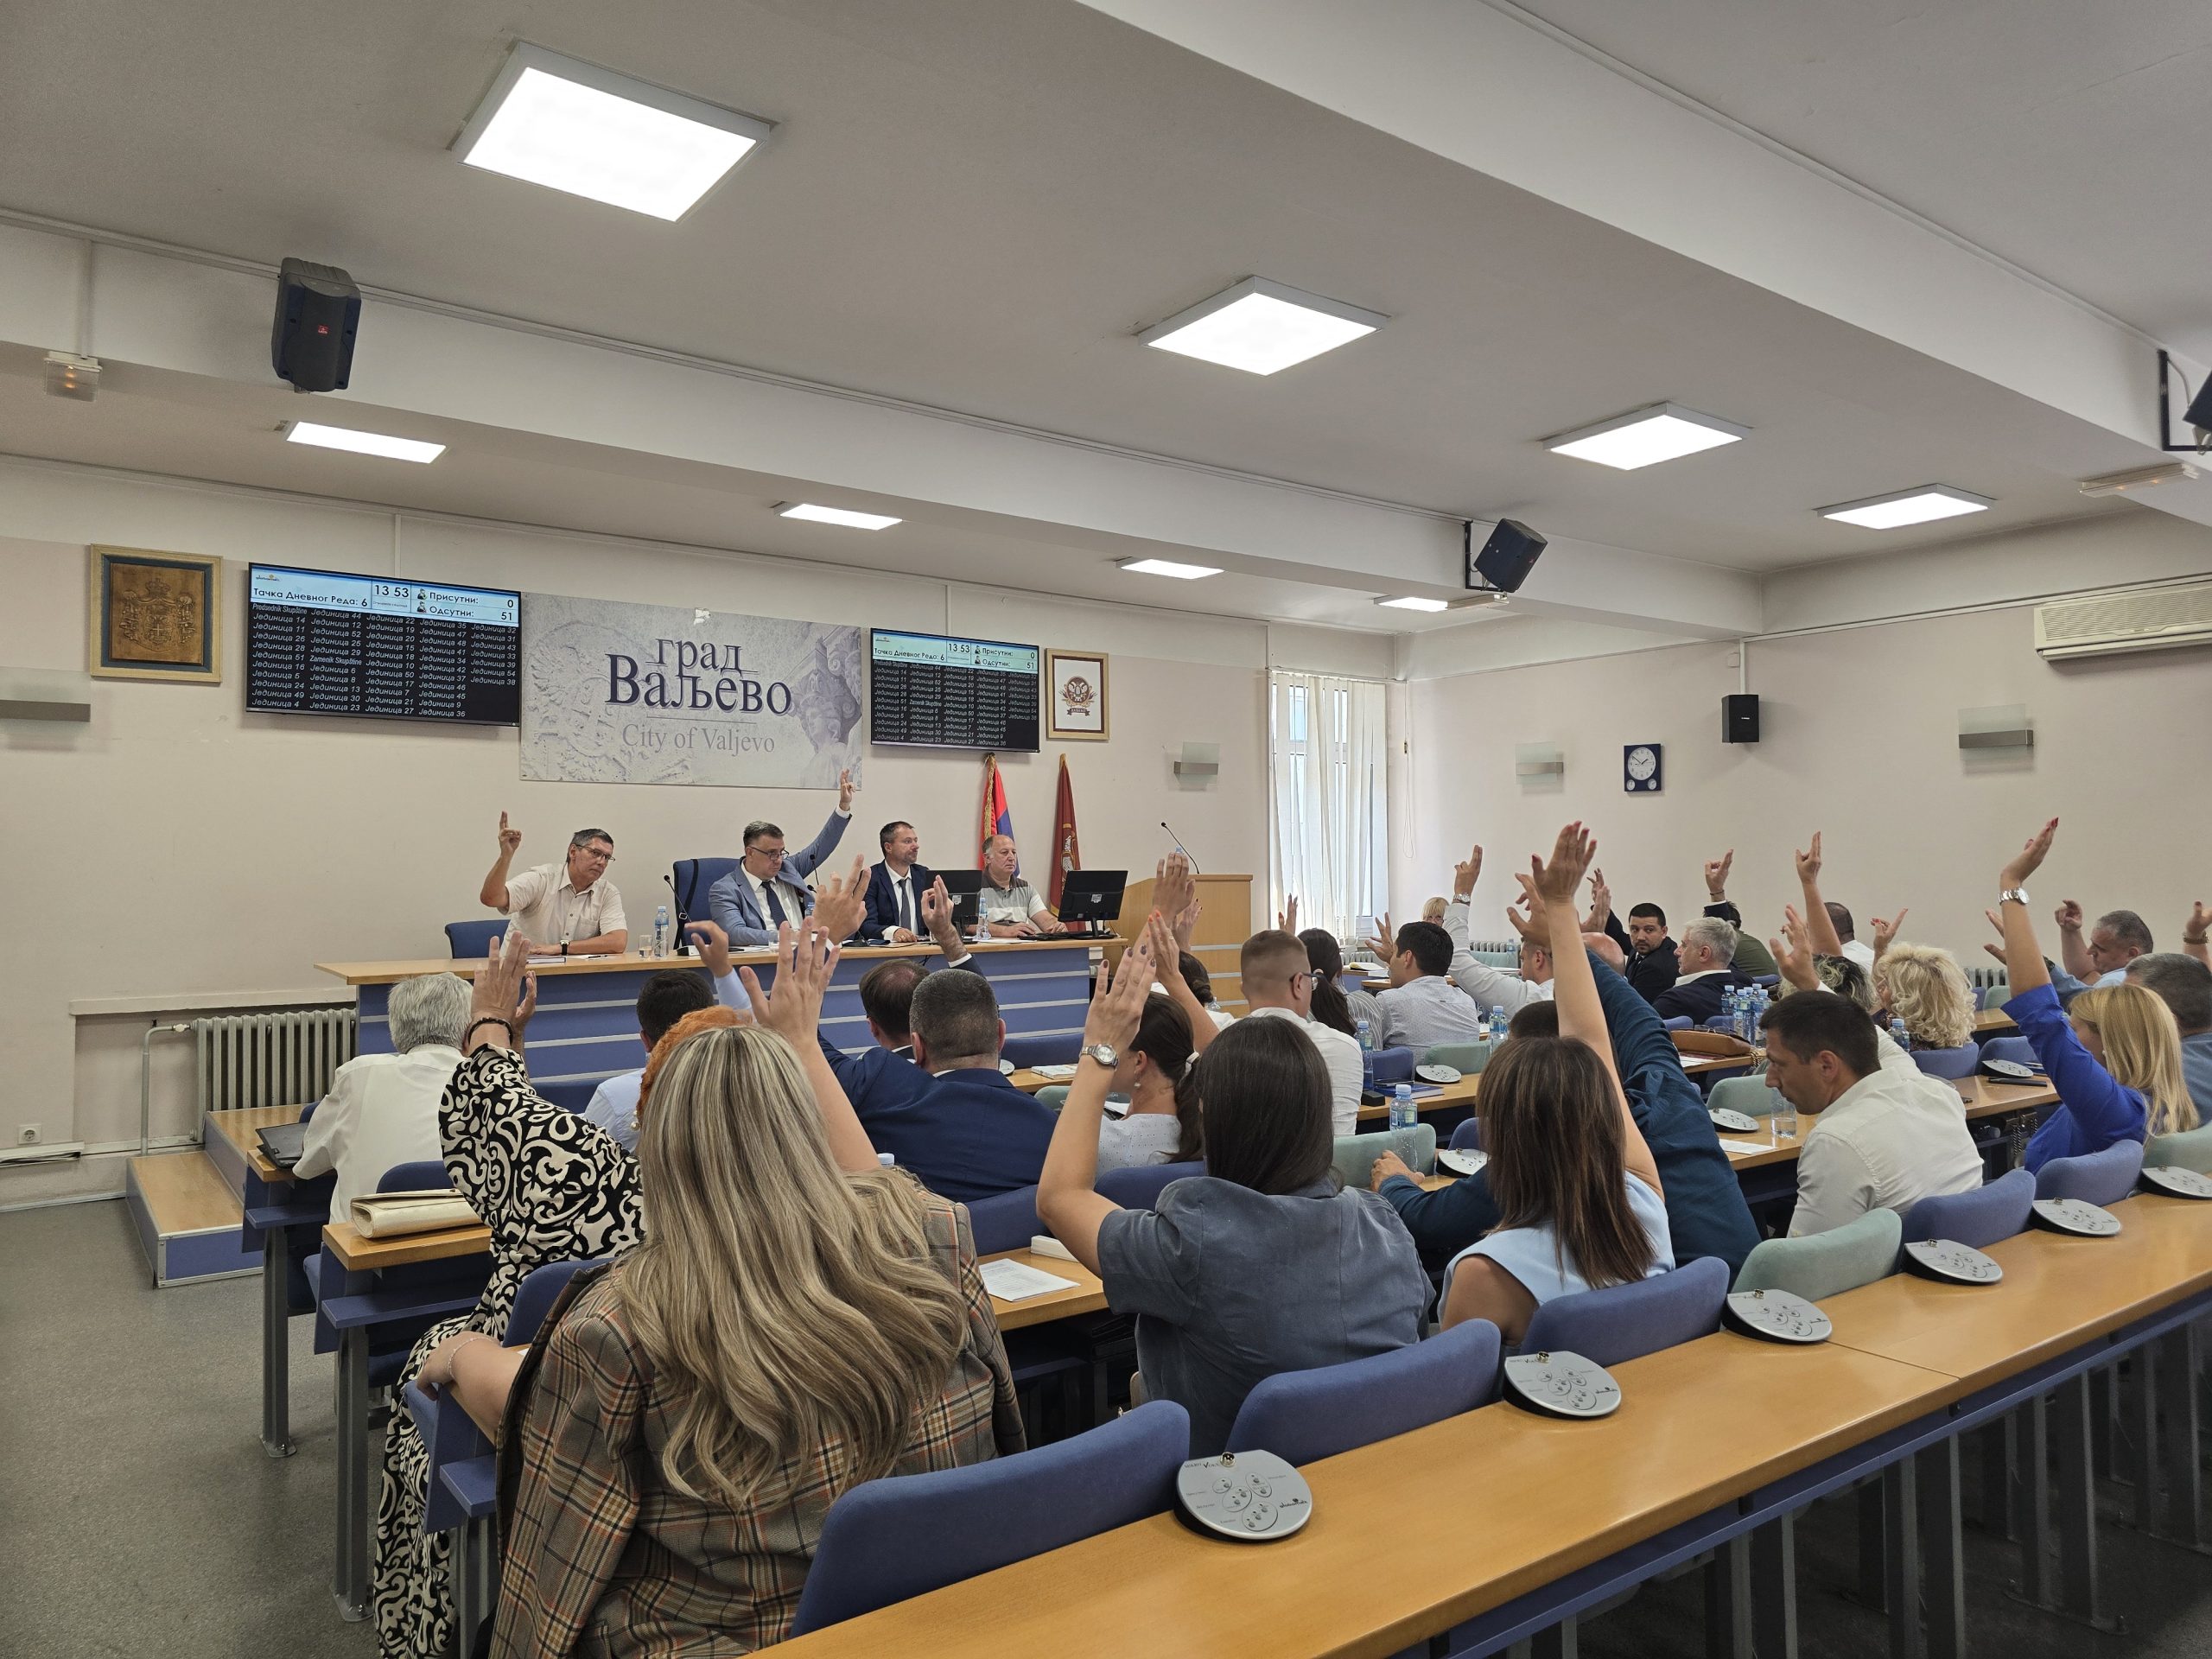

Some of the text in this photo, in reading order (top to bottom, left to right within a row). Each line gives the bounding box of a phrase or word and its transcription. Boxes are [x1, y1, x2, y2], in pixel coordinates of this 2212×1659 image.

[375, 584, 409, 597] 13 53
[253, 588, 283, 597] Тачка
[285, 591, 327, 601] Дневног
[331, 595, 357, 605] Реда:
[361, 598, 367, 607] 6
[429, 592, 513, 607] Присутни: 0
[253, 613, 293, 623] Јединица
[310, 608, 349, 619] Јединица
[429, 606, 512, 620] Одсутни: 51
[310, 618, 349, 627] Јединица
[365, 613, 403, 624] Јединица
[419, 619, 455, 628] Јединица
[252, 622, 293, 632] Јединица
[310, 627, 349, 637] Јединица
[365, 622, 403, 632] Јединица
[419, 627, 454, 637] Јединица
[470, 623, 505, 632] Јединица
[252, 632, 293, 641] Јединица
[310, 636, 348, 646] Јединица
[365, 632, 403, 641] Јединица
[419, 636, 454, 646] Јединица
[470, 632, 505, 642] Јединица
[252, 641, 292, 652] Јединица
[310, 645, 348, 655] Јединица
[365, 641, 403, 651] Јединица
[419, 645, 454, 655] Јединица
[470, 640, 505, 651] Јединица
[252, 651, 292, 660] Јединица
[365, 650, 403, 659] Јединица
[419, 654, 454, 664] Јединица
[470, 650, 505, 659] Јединица
[655, 638, 744, 677] град
[252, 660, 292, 670] Јединица
[365, 659, 403, 669] Јединица
[419, 664, 454, 672] Јединица
[470, 658, 505, 668] Јединица
[309, 664, 348, 674] Јединица
[365, 668, 403, 677] Јединица
[470, 667, 505, 677] Јединица
[251, 670, 292, 679] Јединица
[309, 673, 348, 683] Јединица
[418, 672, 454, 682] Јединица
[251, 679, 292, 689] Јединица
[365, 677, 402, 687] Јединица
[418, 681, 454, 690] Јединица
[470, 676, 505, 685] Јединица
[605, 652, 793, 716] Ваљево
[309, 683, 348, 692] Јединица
[365, 686, 402, 696] Јединица
[251, 689, 291, 698] Јединица
[309, 692, 348, 702] Јединица
[418, 690, 454, 699] Јединица
[251, 698, 291, 708] Јединица
[365, 696, 402, 705] Јединица
[418, 699, 454, 709] Јединица
[309, 702, 347, 710] Јединица
[365, 705, 402, 714] Јединица
[418, 708, 454, 717] Јединица
[622, 723, 776, 757] City of Valjevo
